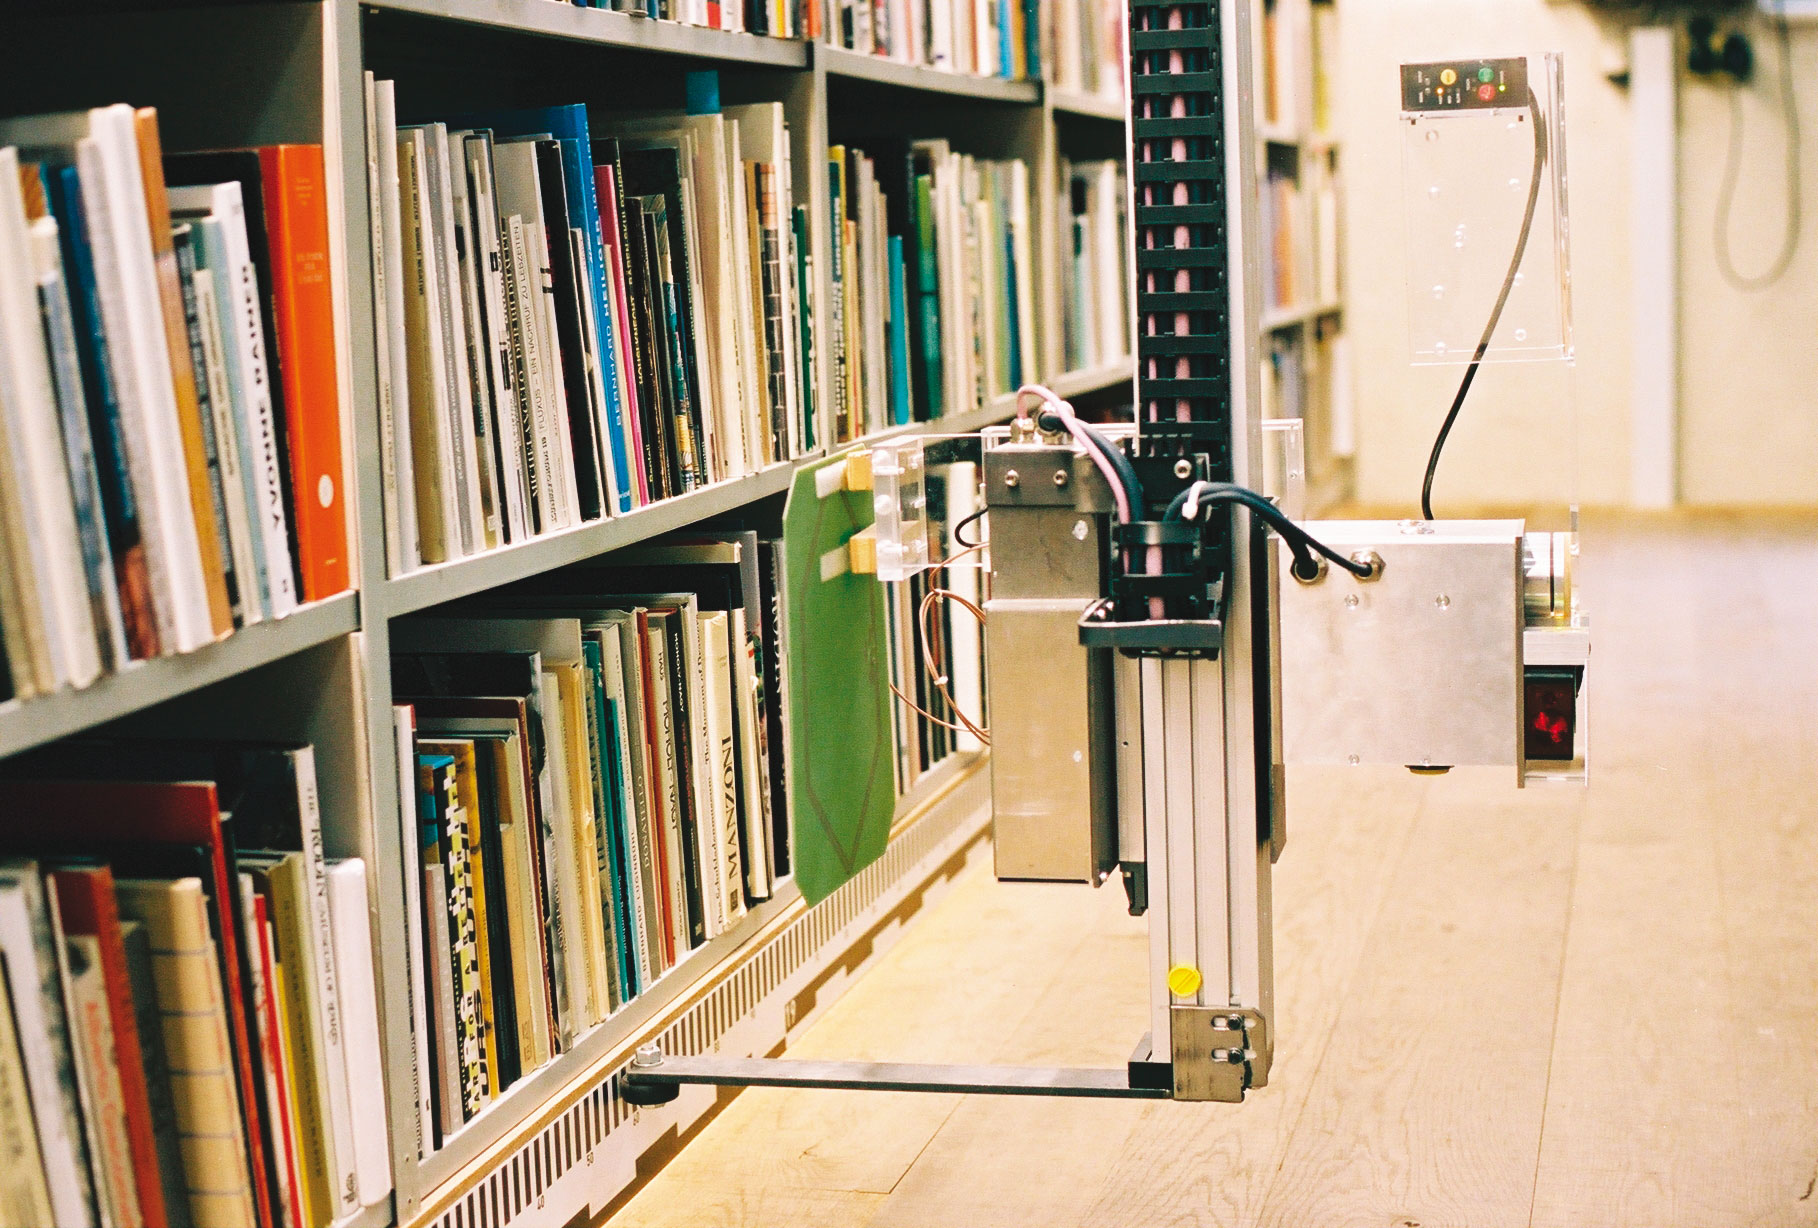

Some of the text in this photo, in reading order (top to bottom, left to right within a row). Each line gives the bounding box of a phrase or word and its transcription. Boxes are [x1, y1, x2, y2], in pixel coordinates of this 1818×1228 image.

[514, 225, 526, 282] LEBZEITEN
[522, 284, 528, 300] ZU
[595, 217, 610, 317] HEILIGER
[525, 303, 535, 354] NACHRUF
[241, 263, 282, 530] YVONNE RAINER
[535, 387, 546, 431] FLUXUS
[606, 324, 622, 427] BERNHARD
[519, 369, 538, 498] MICHELANGELO
[674, 632, 684, 713] MOHOLY-NAGY
[638, 774, 650, 868] DONATELLO
[721, 735, 738, 880] MANZONI
[451, 775, 480, 1102] ART FOR A BETTER LIFE
[637, 904, 647, 972] BERNHARD
[586, 1151, 594, 1167] 50
